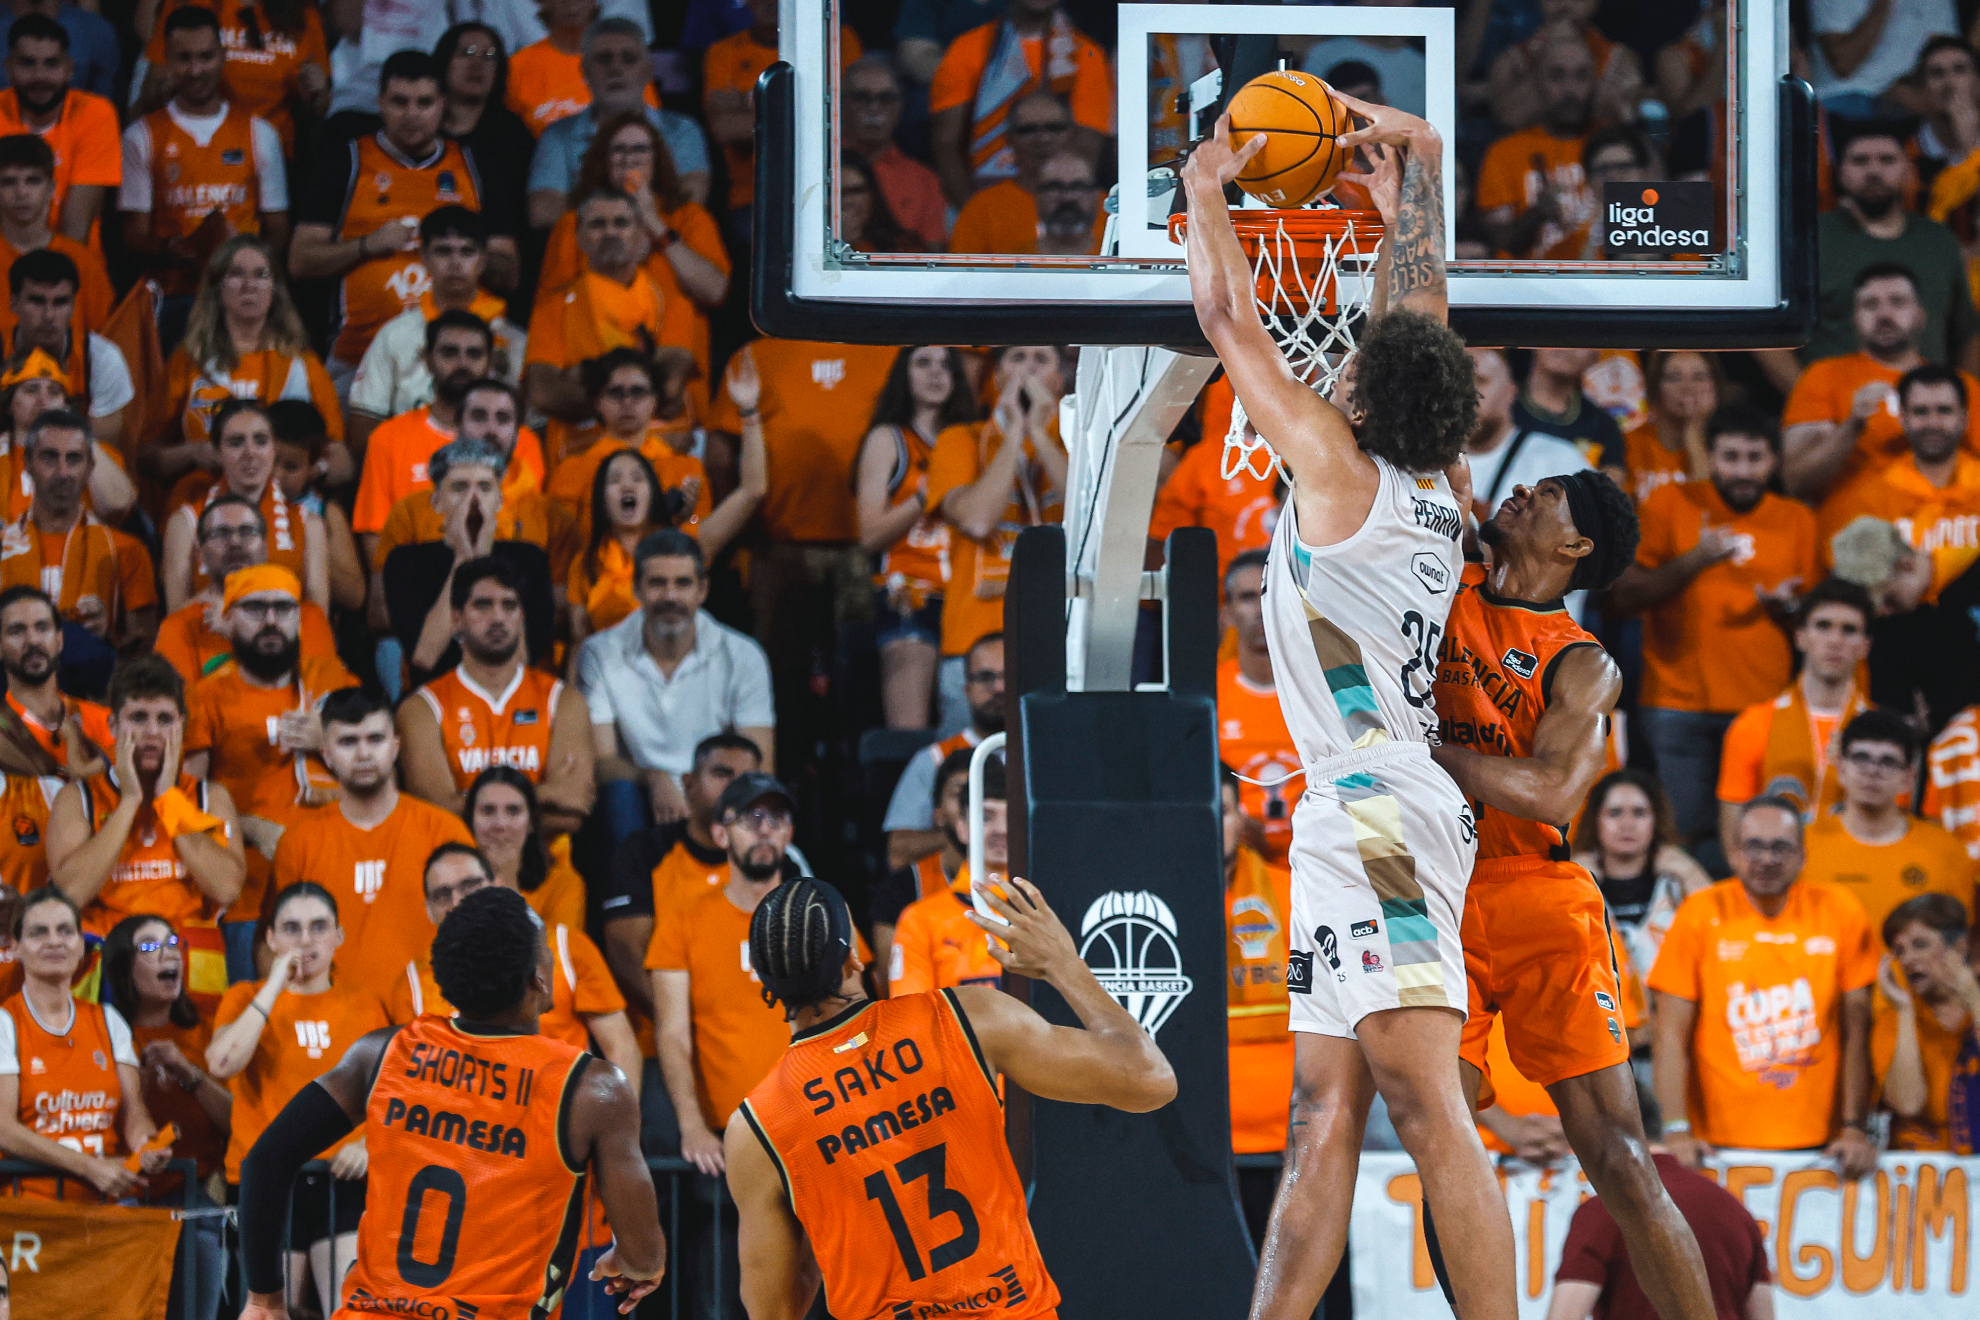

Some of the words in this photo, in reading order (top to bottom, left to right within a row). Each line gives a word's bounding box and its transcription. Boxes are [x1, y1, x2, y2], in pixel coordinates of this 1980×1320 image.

[1608, 201, 1654, 227] liga
[1609, 225, 1709, 247] endesa
[1390, 261, 1434, 295] SELF
[1419, 561, 1445, 585] ownat
[1437, 635, 1522, 719] ALENCIA
[1353, 925, 1374, 937] acb
[1138, 981, 1185, 992] BASKET
[1726, 977, 1815, 1030] COPA
[35, 1088, 106, 1114] Cultura
[405, 1042, 507, 1101] SHORTS
[515, 1067, 534, 1107] II
[803, 1037, 924, 1116] SAKO
[384, 1096, 527, 1160] PAMESA
[816, 1086, 956, 1165] PAMESA
[396, 1164, 467, 1289] 0
[863, 1141, 981, 1283] 13
